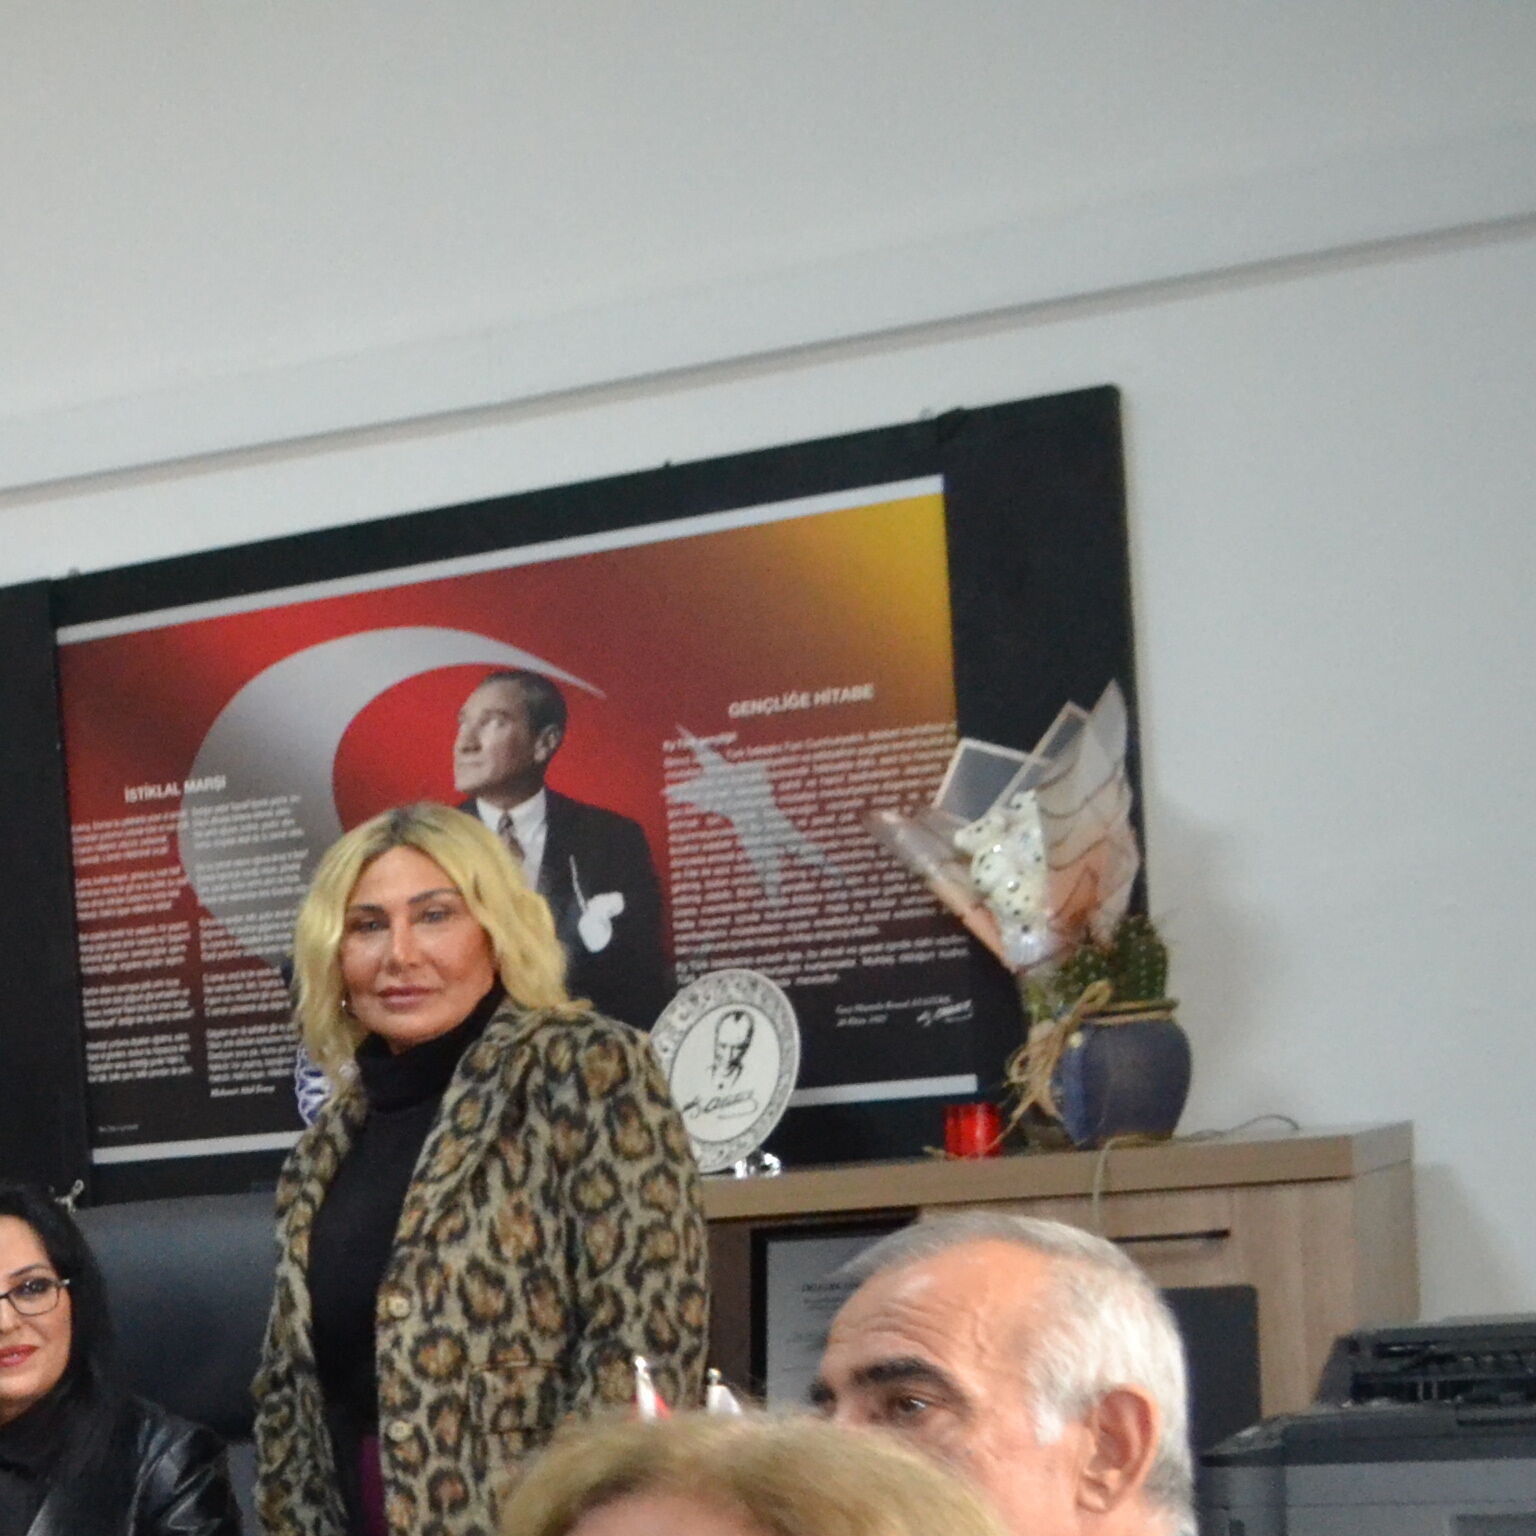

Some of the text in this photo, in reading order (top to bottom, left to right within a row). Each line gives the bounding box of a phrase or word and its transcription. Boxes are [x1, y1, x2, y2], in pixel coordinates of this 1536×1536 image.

[728, 690, 811, 719] GENÇLİĞE
[124, 774, 226, 803] İSTİKLAL MARŞI
